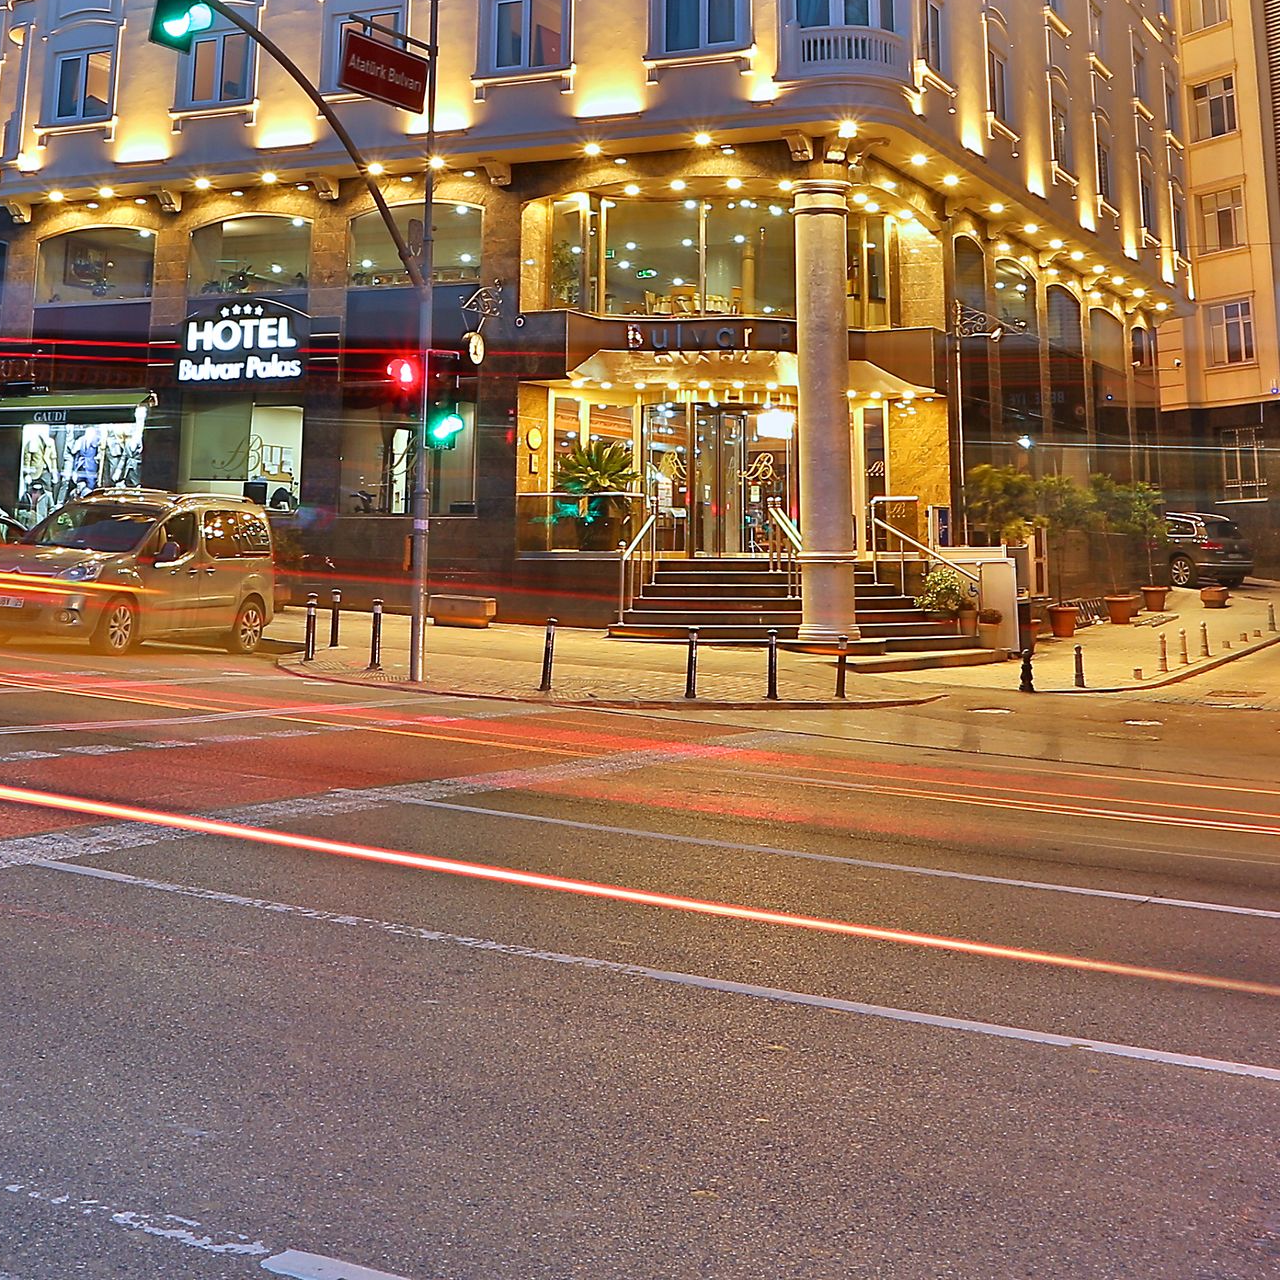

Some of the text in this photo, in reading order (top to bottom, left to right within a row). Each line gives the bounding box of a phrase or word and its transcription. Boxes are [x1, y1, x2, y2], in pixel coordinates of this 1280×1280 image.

[348, 53, 422, 93] Atatürk Bulvarı
[187, 316, 297, 352] HOTEL
[627, 323, 753, 349] Bulvar
[179, 353, 302, 381] Bulvar Palas
